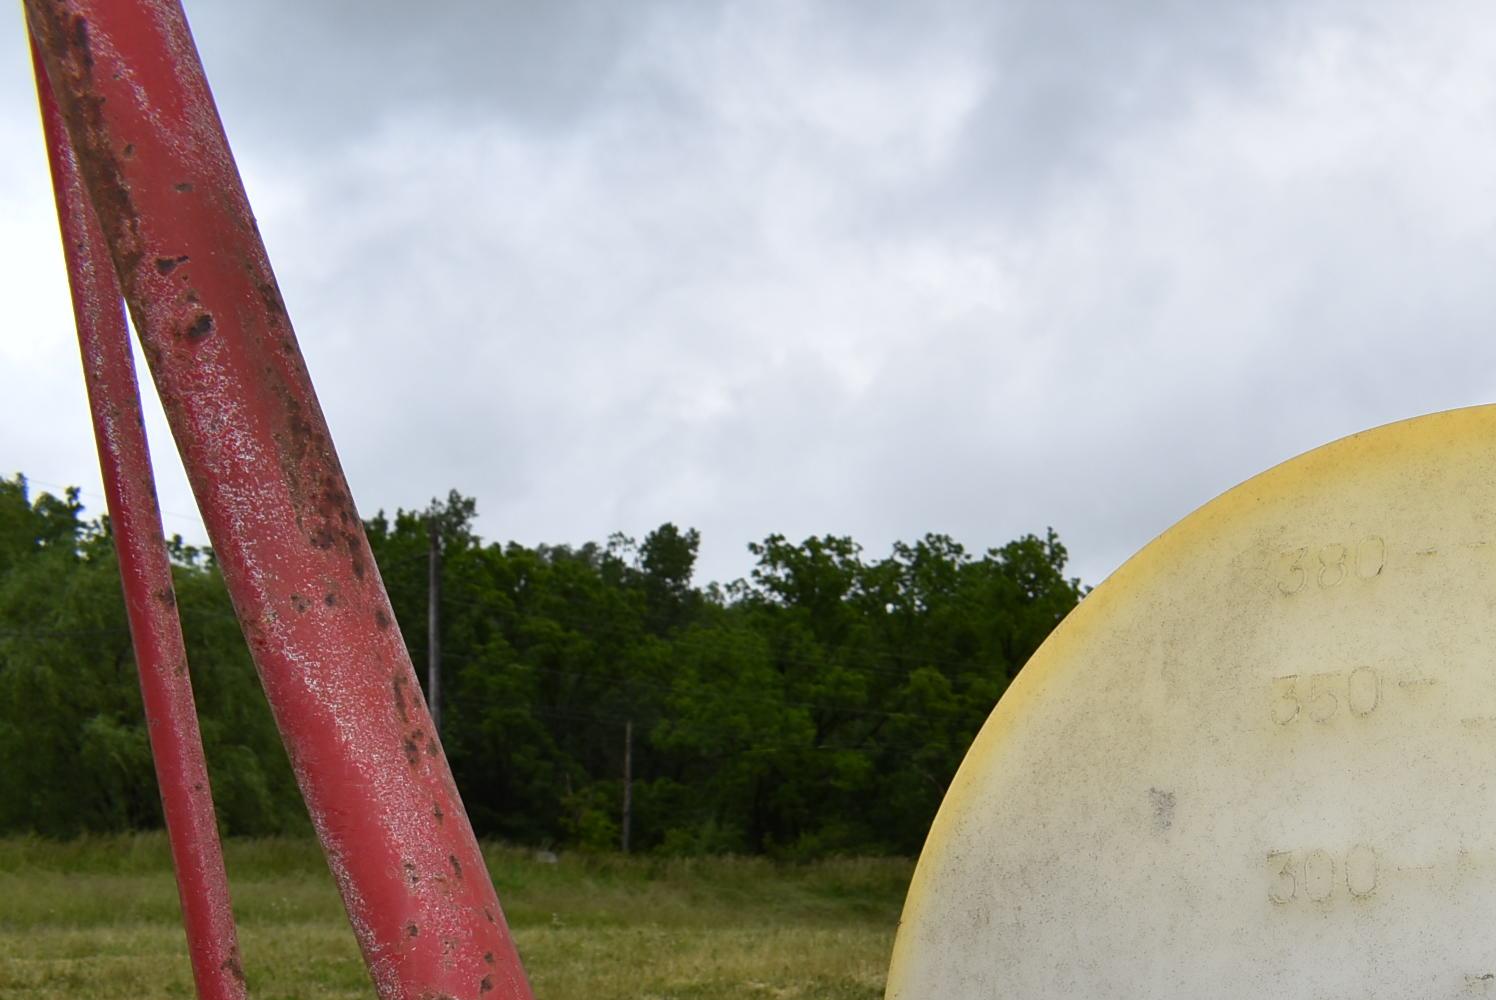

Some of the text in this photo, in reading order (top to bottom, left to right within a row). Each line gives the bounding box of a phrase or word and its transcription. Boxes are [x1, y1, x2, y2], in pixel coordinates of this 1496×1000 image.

[1276, 535, 1386, 597] 380
[1269, 665, 1381, 726] 350
[1266, 844, 1380, 904] 300
